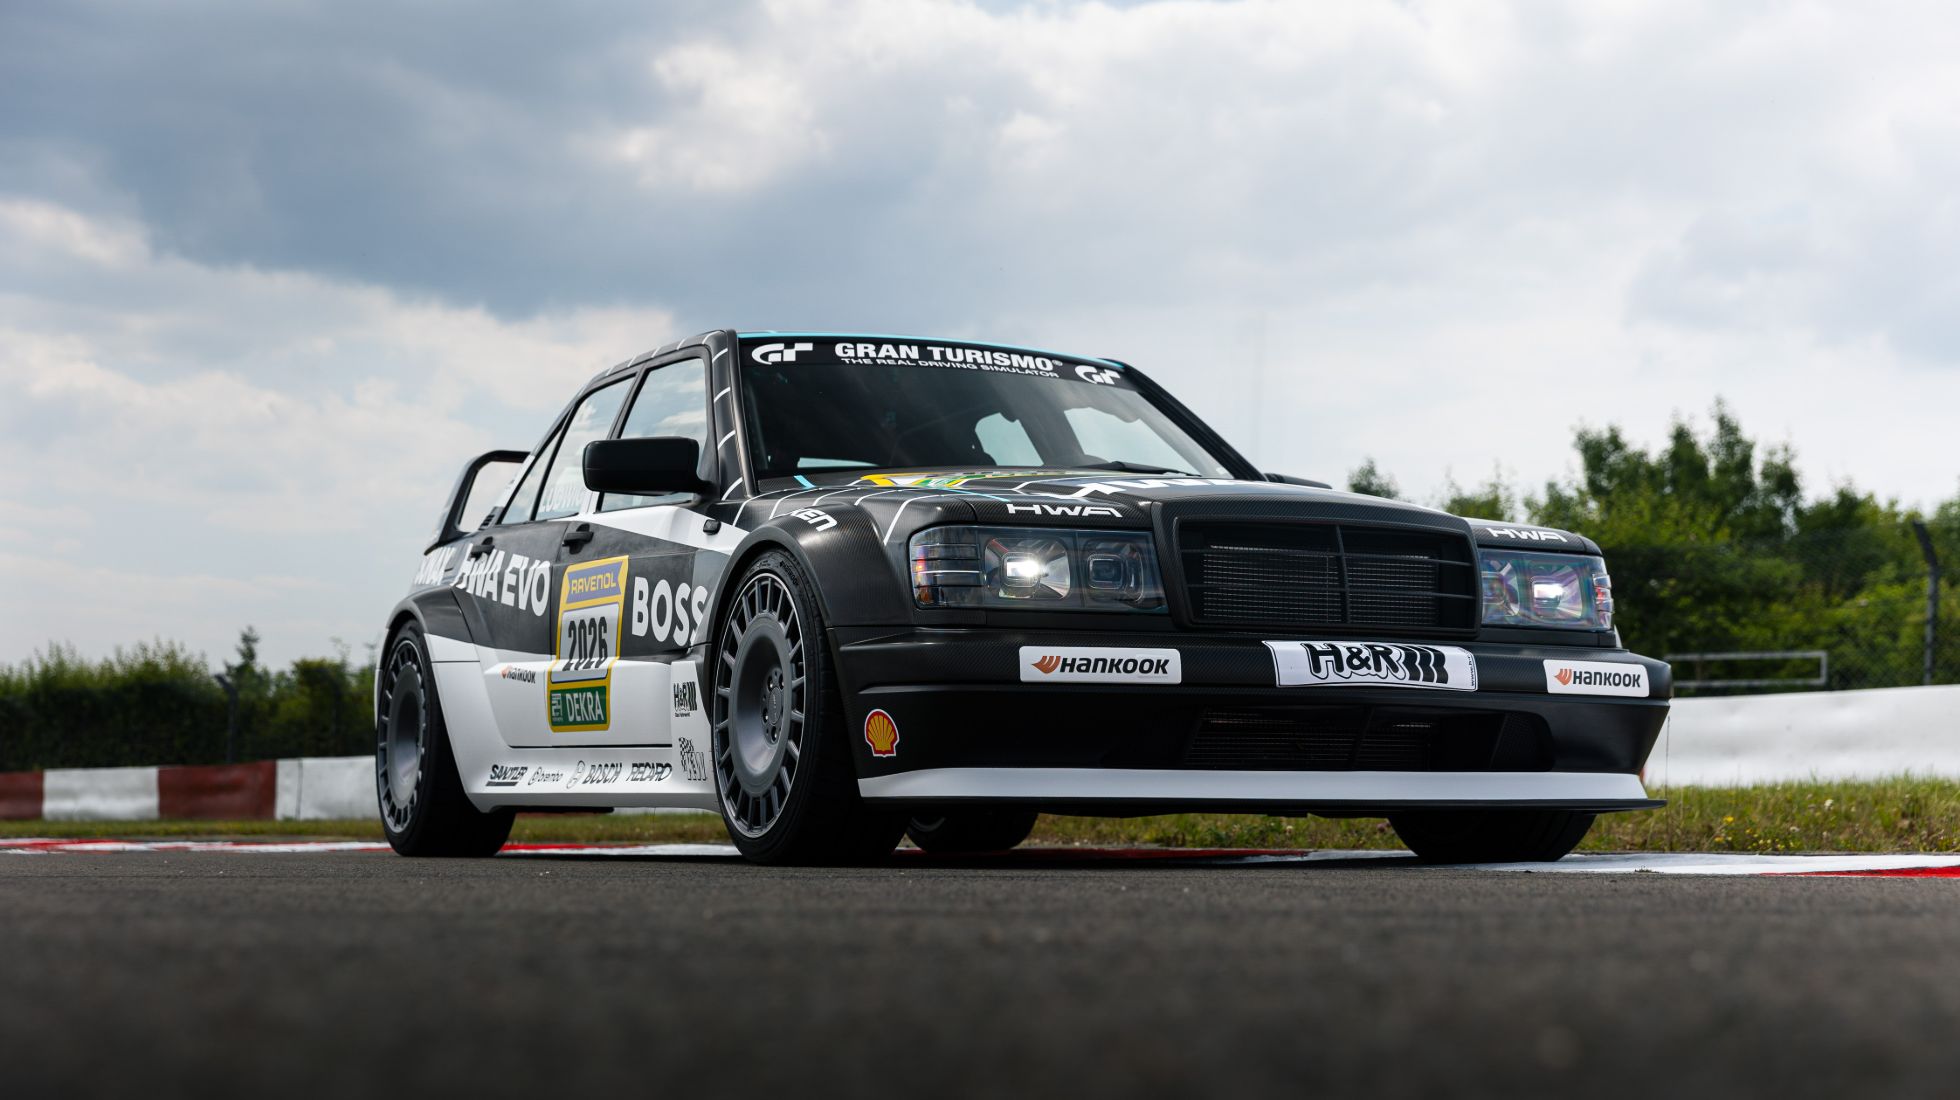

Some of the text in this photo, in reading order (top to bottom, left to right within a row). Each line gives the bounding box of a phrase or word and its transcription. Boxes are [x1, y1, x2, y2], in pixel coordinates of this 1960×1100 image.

[834, 342, 920, 360] GRAN
[840, 357, 1060, 379] THE REAL DRIVING SIMULATOR
[1006, 503, 1123, 518] HWA
[1485, 527, 1568, 543] HWA
[501, 553, 551, 617] EVO
[571, 572, 617, 594] RAVENOL
[631, 576, 709, 653] BOSS
[562, 616, 609, 672] 2026
[1059, 657, 1170, 675] HANKOOK
[1301, 642, 1405, 680] H&R
[1572, 669, 1641, 688] HANKOOK
[565, 690, 605, 722] DEKRA
[582, 762, 623, 785] BOSCH
[626, 762, 673, 782] RECARO
